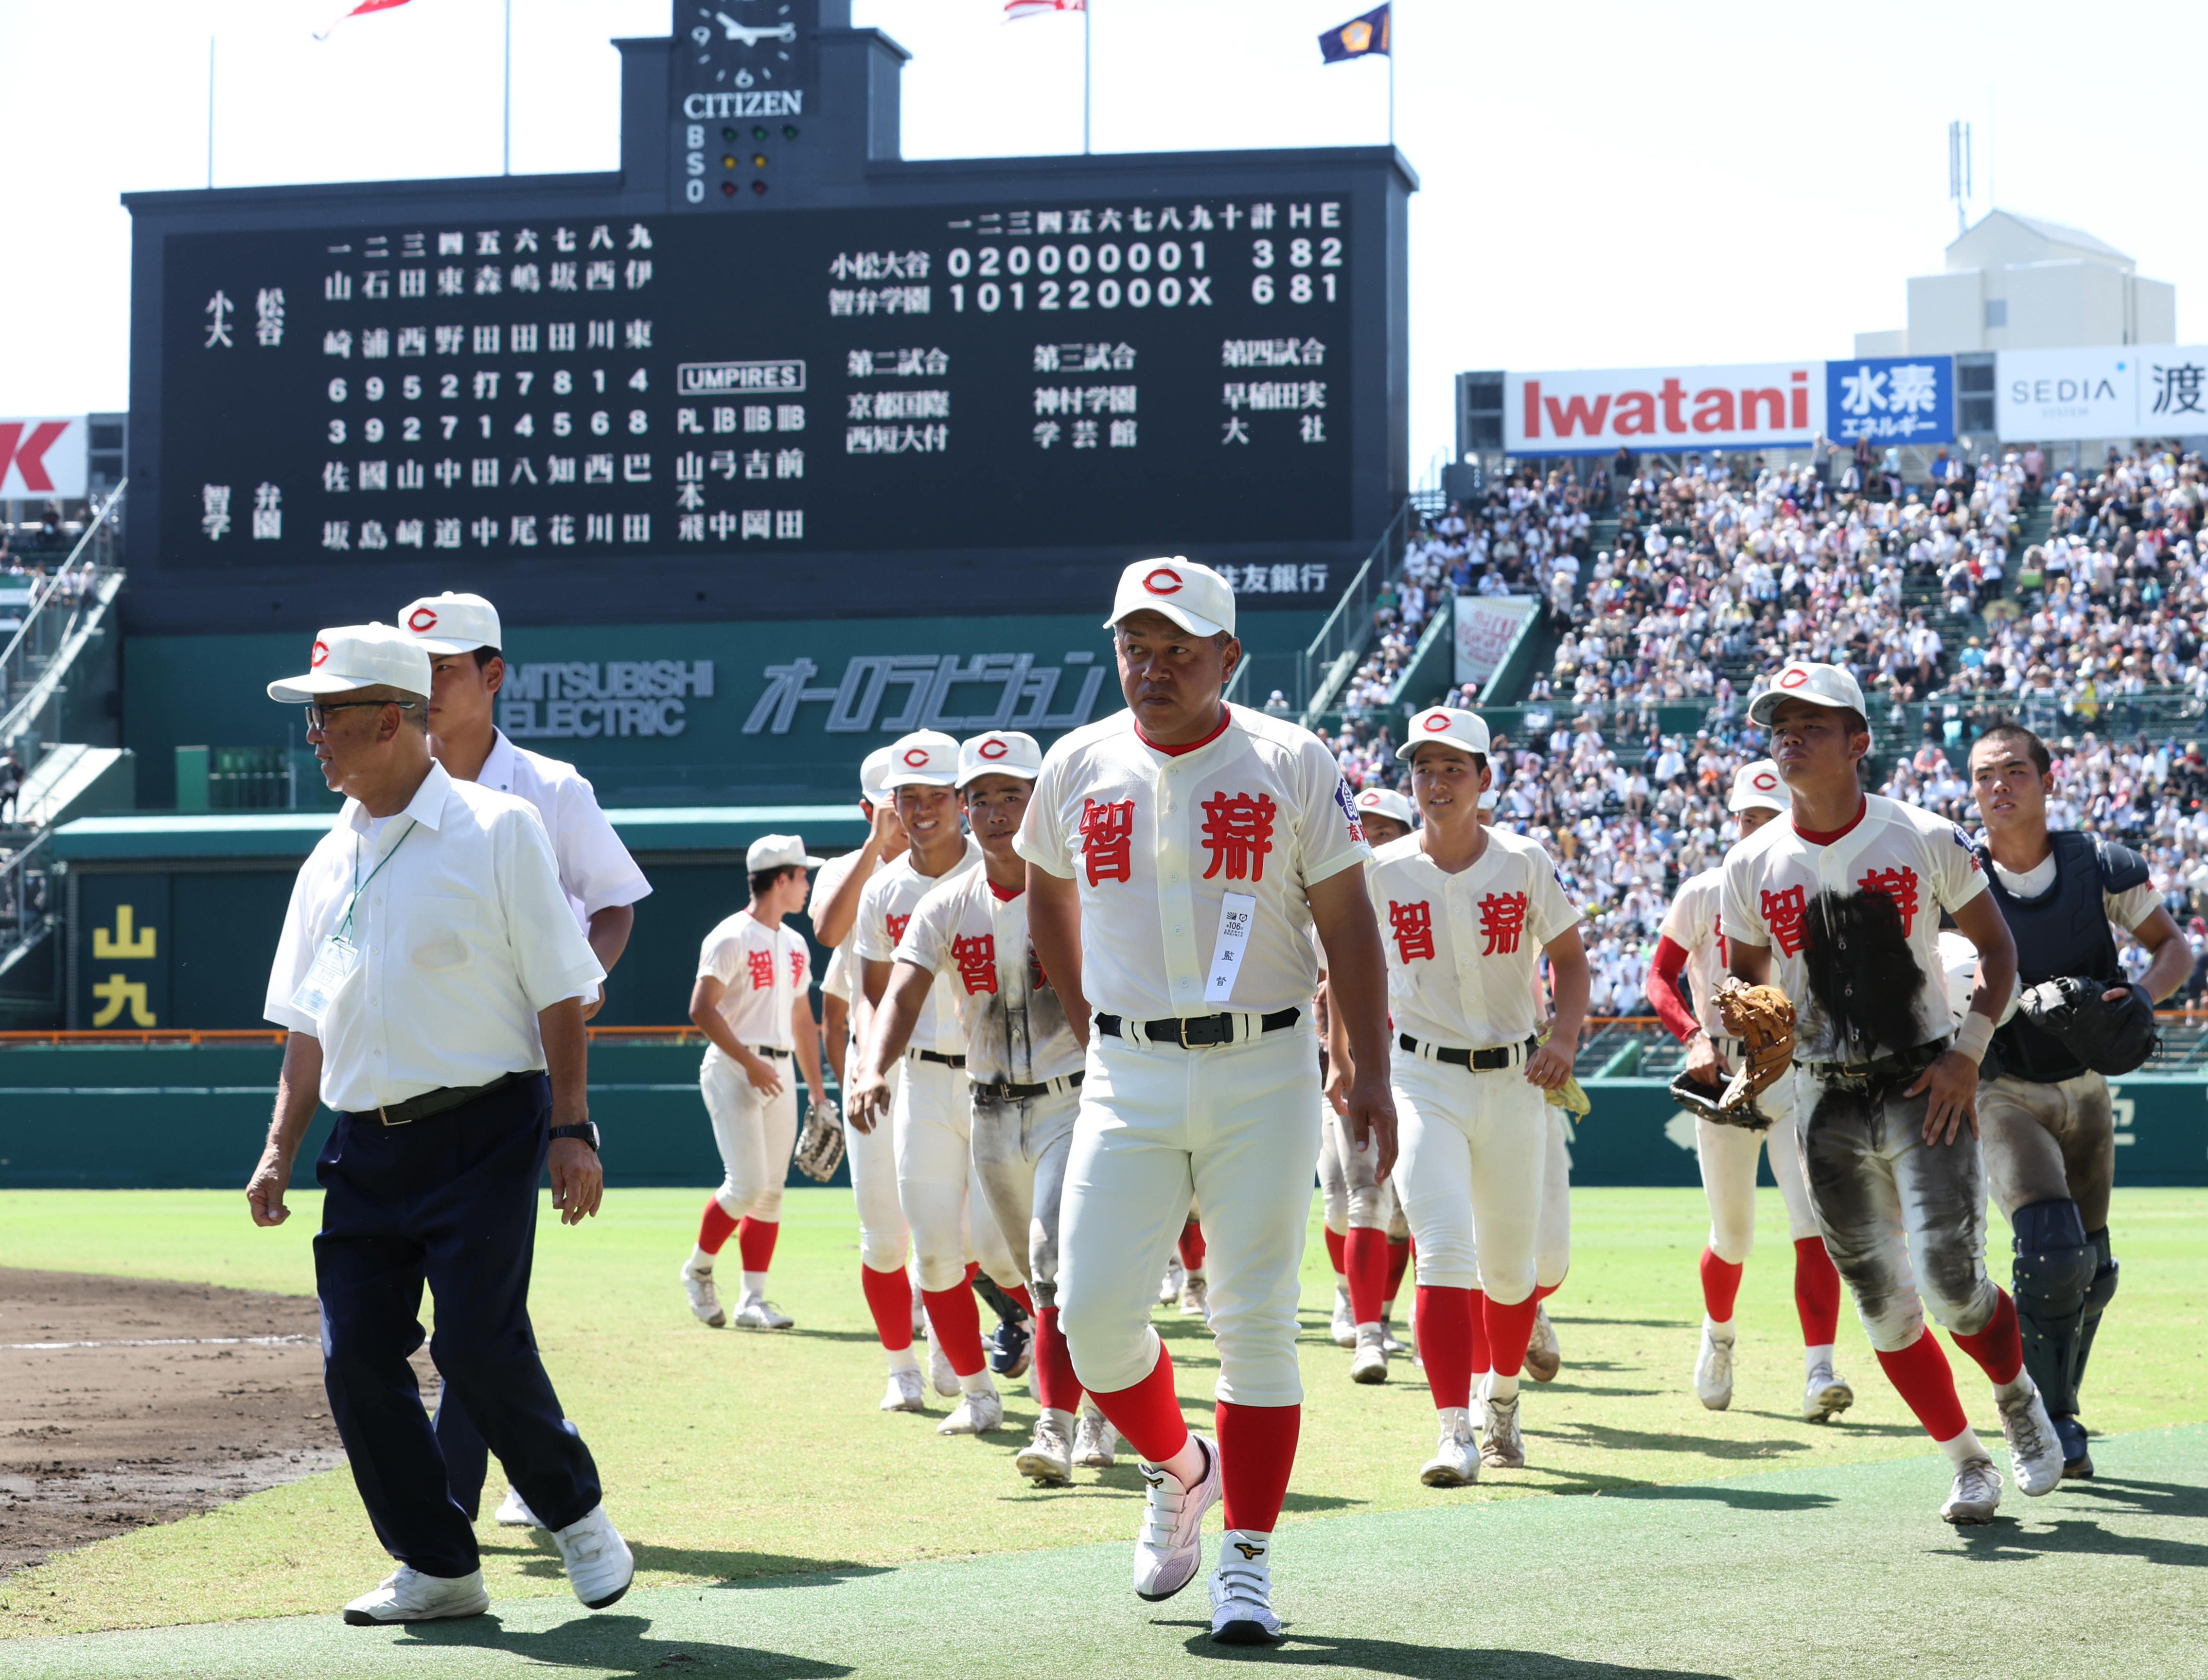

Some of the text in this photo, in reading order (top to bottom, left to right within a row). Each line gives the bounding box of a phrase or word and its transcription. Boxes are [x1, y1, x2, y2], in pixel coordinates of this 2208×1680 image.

[734, 68, 755, 88] 6
[683, 90, 803, 120] CITIZEN
[687, 124, 705, 149] B
[686, 151, 706, 176] S
[686, 178, 705, 203] O
[829, 250, 930, 281] 小松大谷
[829, 285, 931, 316] 智弁学園
[848, 347, 949, 378] 第二試合
[1033, 342, 1136, 372] 第三試合
[1222, 337, 1326, 368] 第四試合
[328, 368, 649, 403] 6 9 5 2 打 7 8 1 4
[686, 367, 796, 389] UMPIRES
[1840, 364, 1938, 416] 水素
[2011, 377, 2117, 404] SEDIA
[848, 389, 949, 420] 京都国際
[1034, 385, 1137, 415] 神村学園
[1223, 380, 1327, 410] 早稲田実
[1526, 373, 1807, 436] Iwatani
[328, 409, 648, 444] 3 9 2 7 1 4 5 6 8
[846, 424, 949, 454] 西短大付
[1840, 415, 1938, 438] エネルギー
[500, 660, 714, 700] MITSUBISHI
[500, 697, 686, 737] ELECTRIC
[93, 905, 156, 1026] 山九
